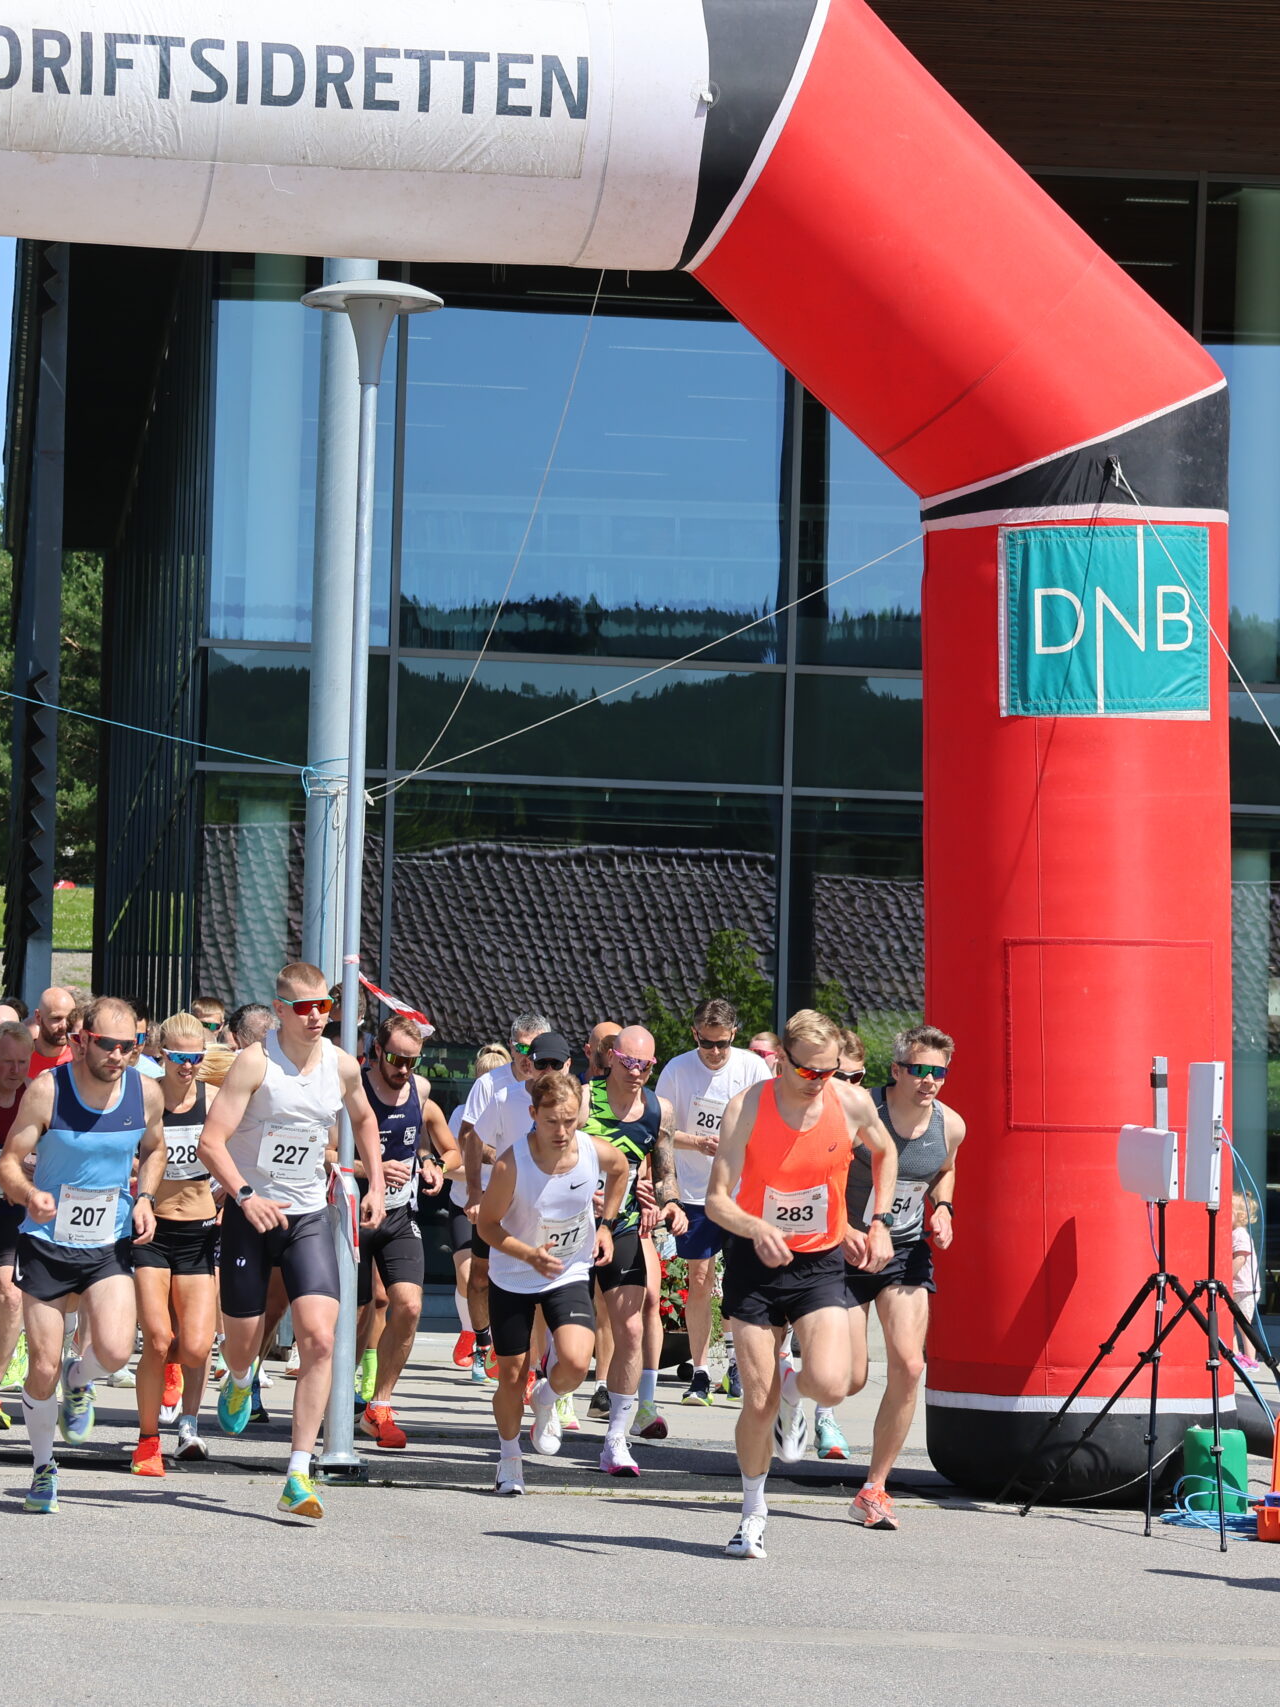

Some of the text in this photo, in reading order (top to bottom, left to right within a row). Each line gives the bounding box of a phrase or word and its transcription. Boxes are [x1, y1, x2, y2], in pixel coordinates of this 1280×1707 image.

[696, 1111, 722, 1130] 287
[167, 1145, 198, 1164] 228
[272, 1144, 309, 1165] 227
[776, 1205, 814, 1222] 283
[891, 1197, 911, 1214] 54
[70, 1206, 106, 1227] 207
[549, 1227, 580, 1247] 277
